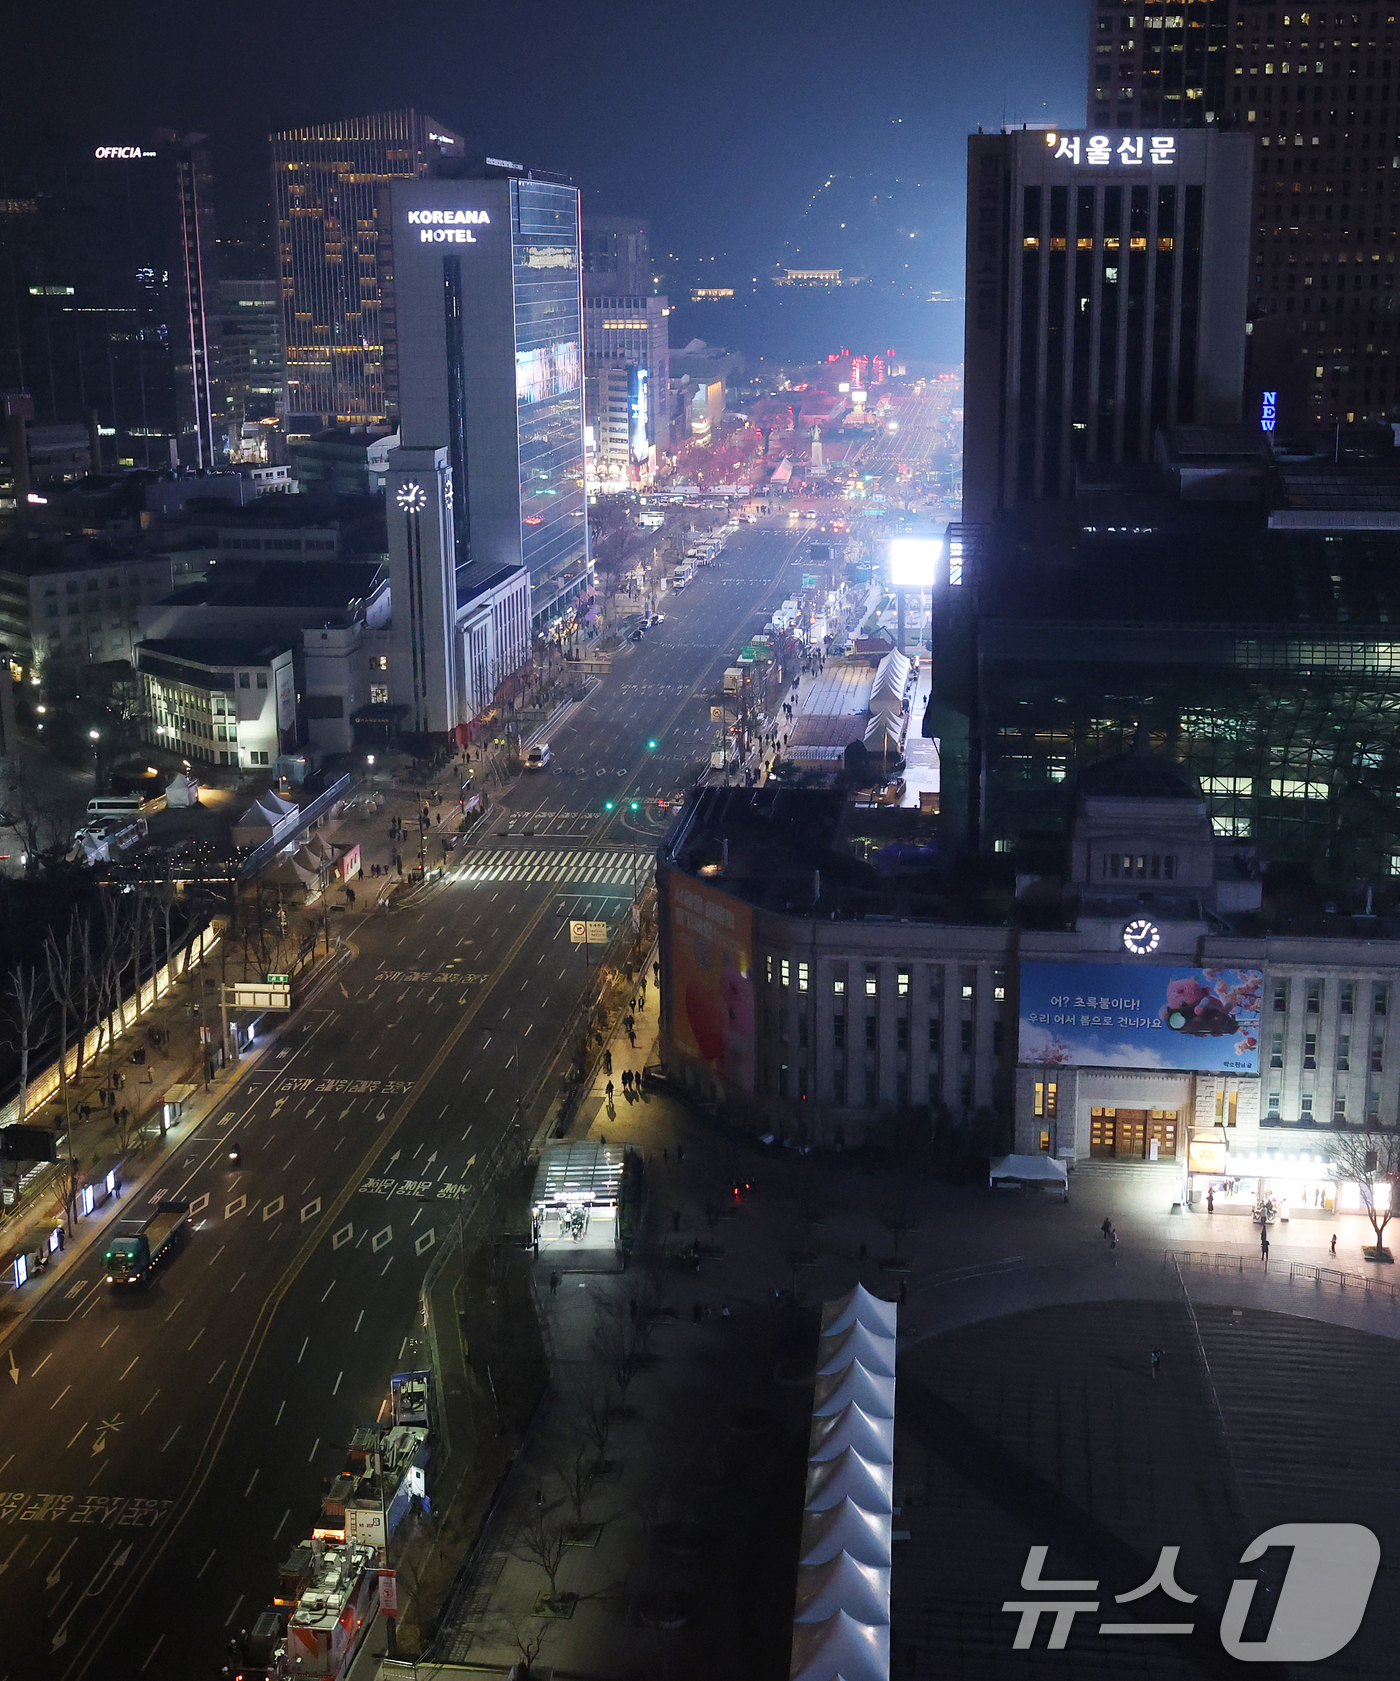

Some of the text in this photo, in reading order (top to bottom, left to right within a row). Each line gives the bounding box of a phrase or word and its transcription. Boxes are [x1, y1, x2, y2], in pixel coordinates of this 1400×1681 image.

[95, 146, 142, 159] OFFICIA
[1054, 136, 1176, 165] 서울신문
[408, 210, 490, 224] KOREANA
[420, 229, 477, 243] HOTEL
[1260, 391, 1277, 431] NEW
[1050, 995, 1141, 1011] 어? 초록불이다!
[1028, 1012, 1163, 1029] 우리 어서 봄으로 건너가요
[358, 1176, 396, 1195] 광화문
[395, 1178, 433, 1198] 광화문
[19, 1493, 75, 1522] 숭례문
